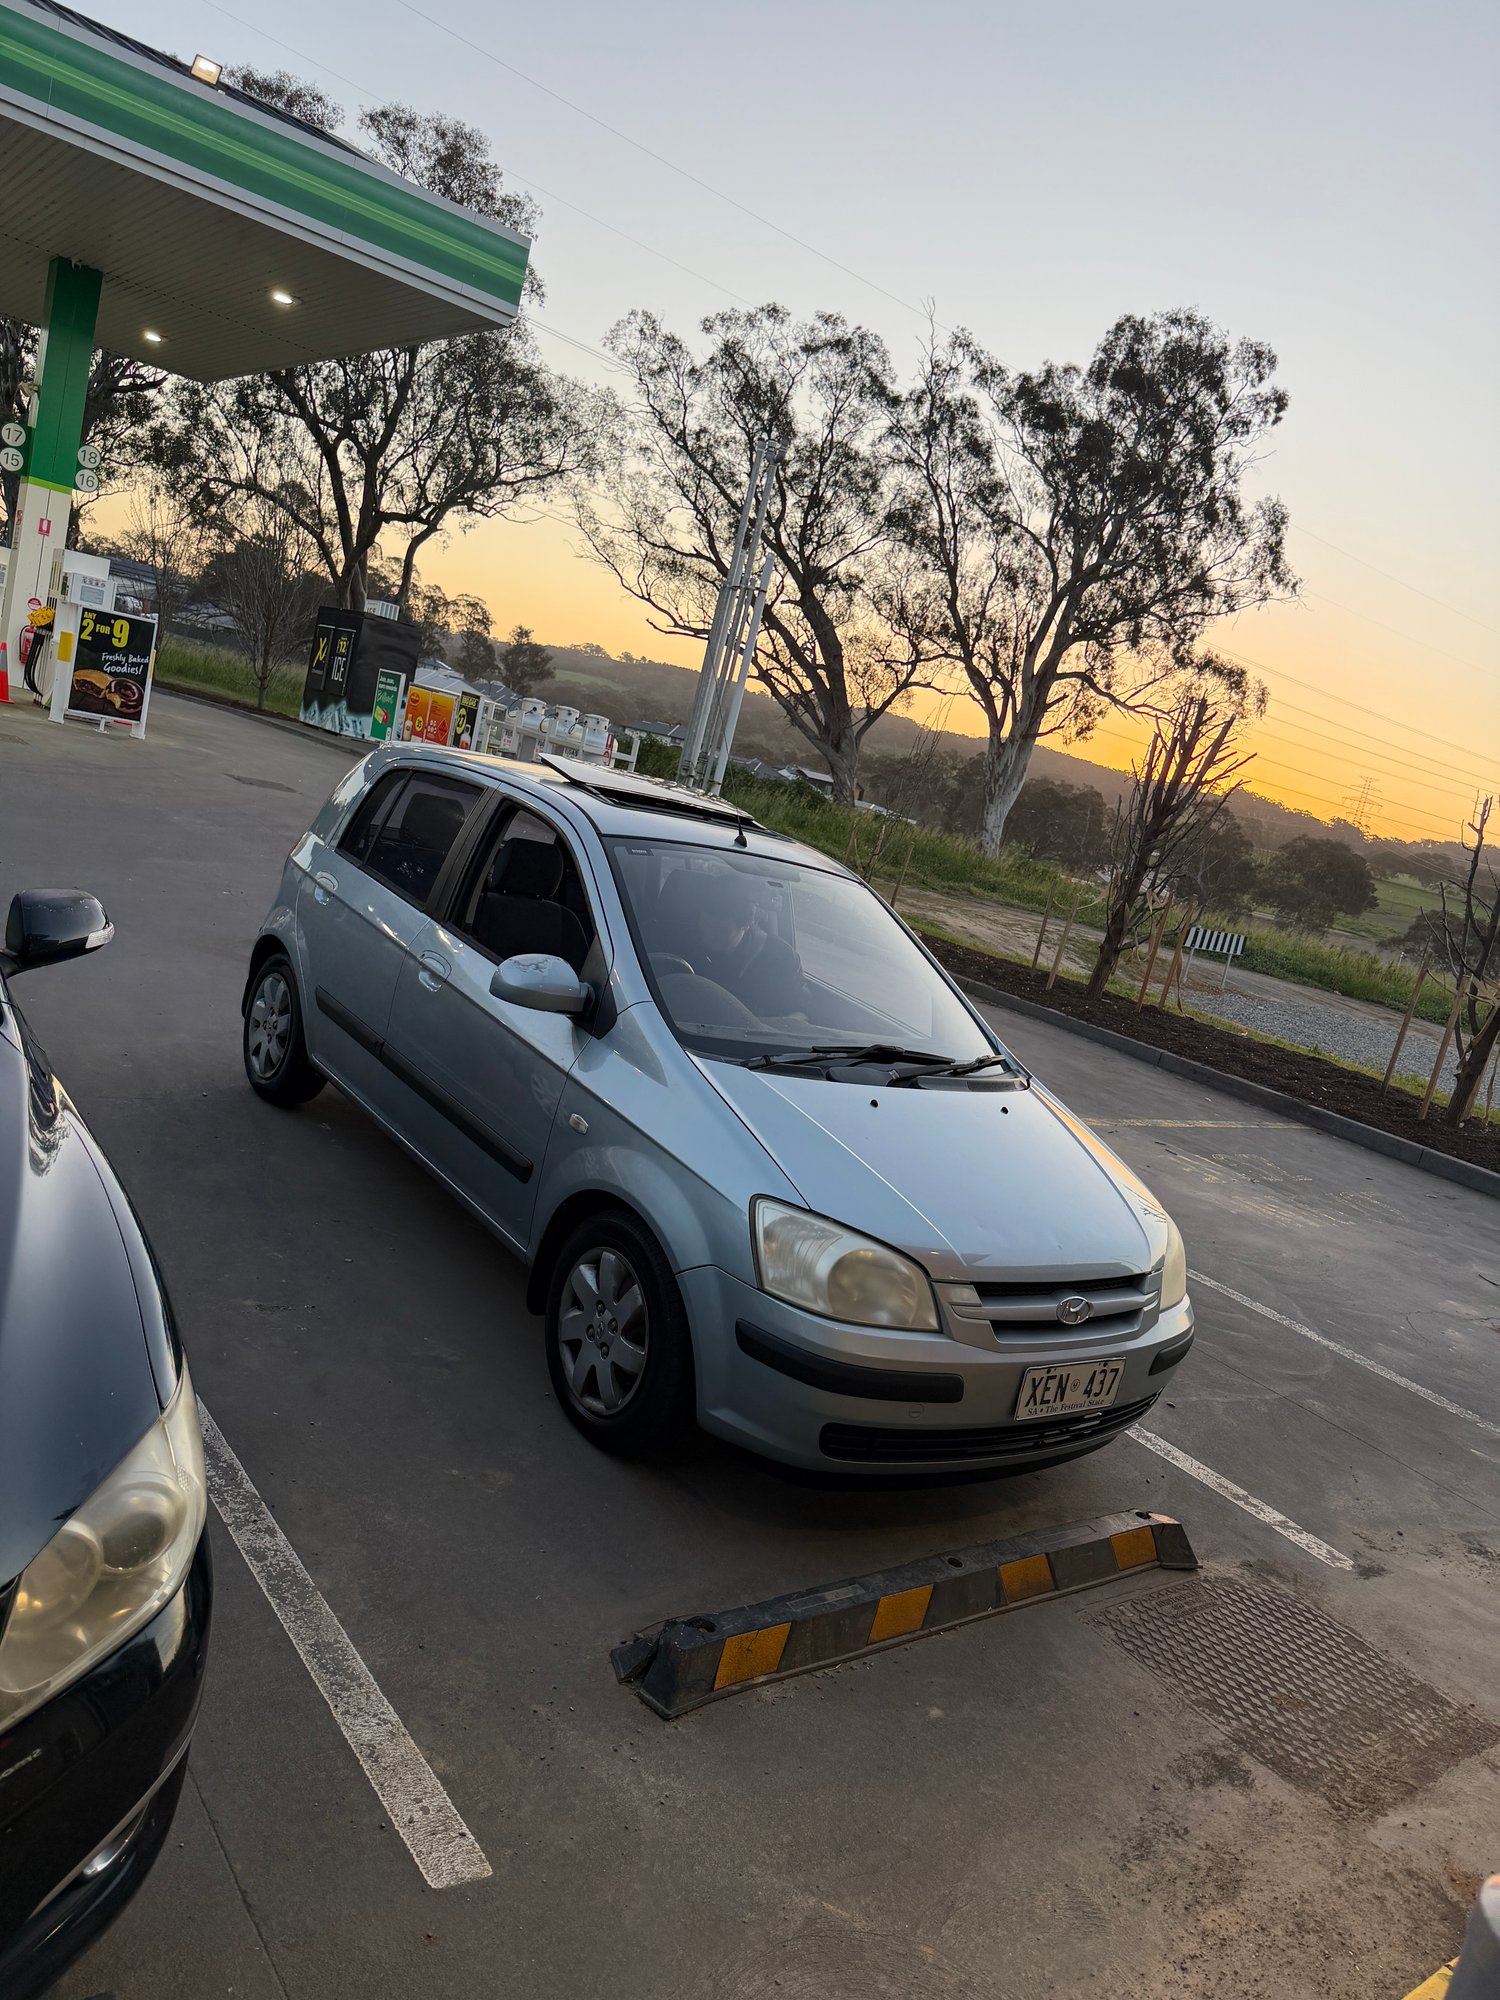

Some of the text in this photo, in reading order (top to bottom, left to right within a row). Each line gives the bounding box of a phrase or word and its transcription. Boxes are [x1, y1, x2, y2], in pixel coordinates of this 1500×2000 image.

[5, 427, 23, 442] 17
[3, 452, 20, 467] 15
[81, 449, 98, 465] 18
[79, 473, 95, 488] 16
[83, 611, 97, 620] ANY
[80, 618, 94, 641] 2
[95, 624, 111, 635] FOR
[101, 652, 149, 664] Freshly Baked
[103, 662, 144, 675] Goodies!
[331, 656, 347, 681] ICE
[1024, 1367, 1120, 1407] XEN 437
[1027, 1399, 1104, 1416] SA The Festival State
